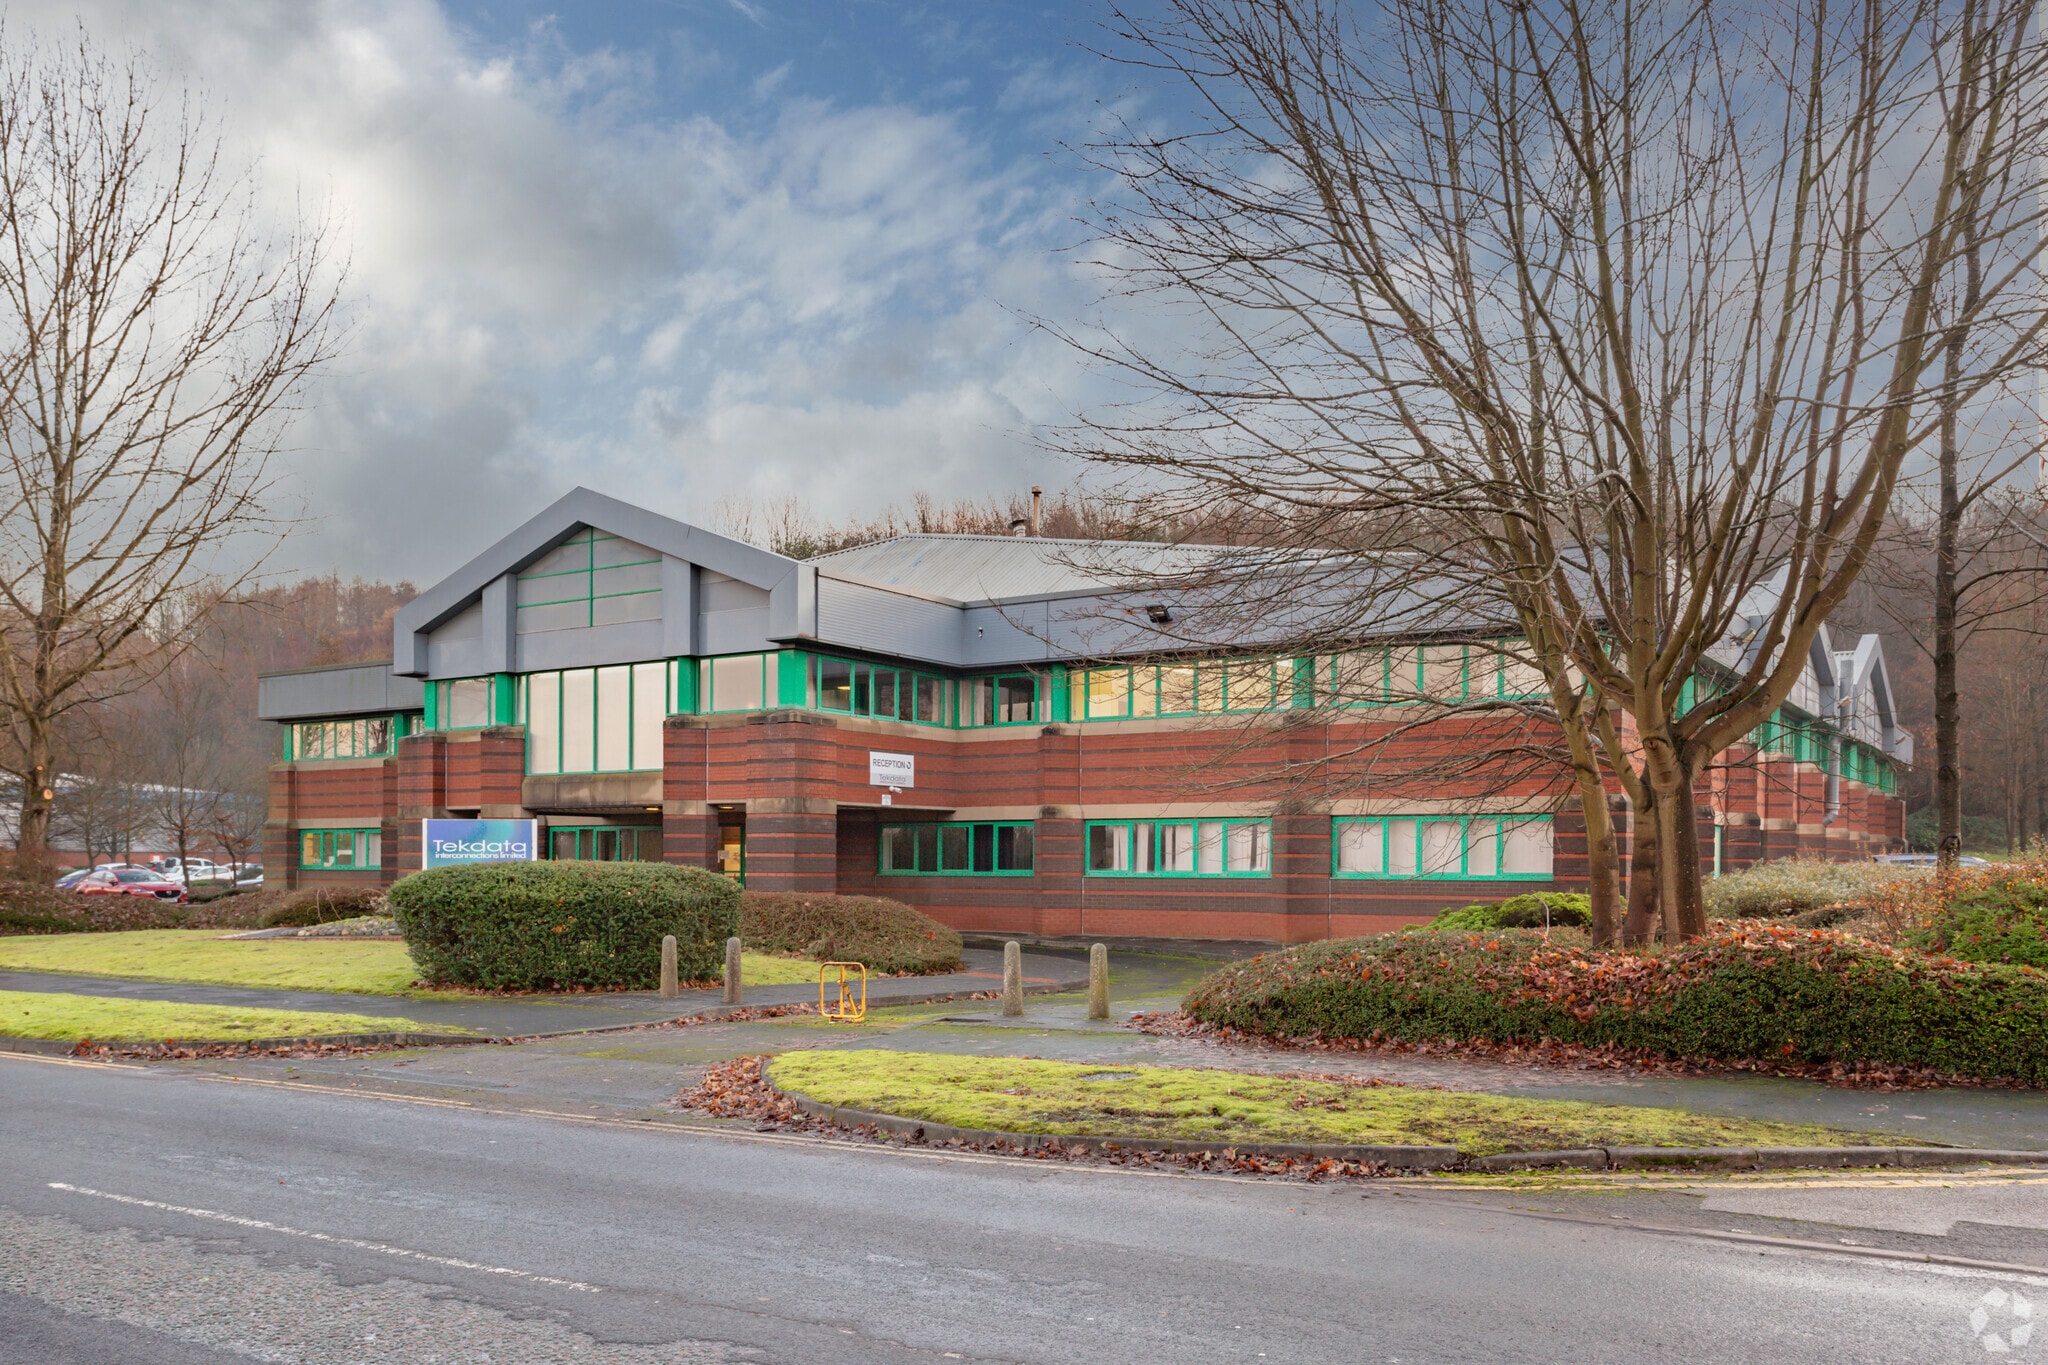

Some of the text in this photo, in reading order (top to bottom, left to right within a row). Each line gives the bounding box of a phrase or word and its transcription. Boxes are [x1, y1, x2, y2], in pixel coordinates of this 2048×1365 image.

[872, 758, 905, 768] RECEPTION
[433, 840, 526, 852] Tekdata
[435, 851, 526, 859] interconnections limited
